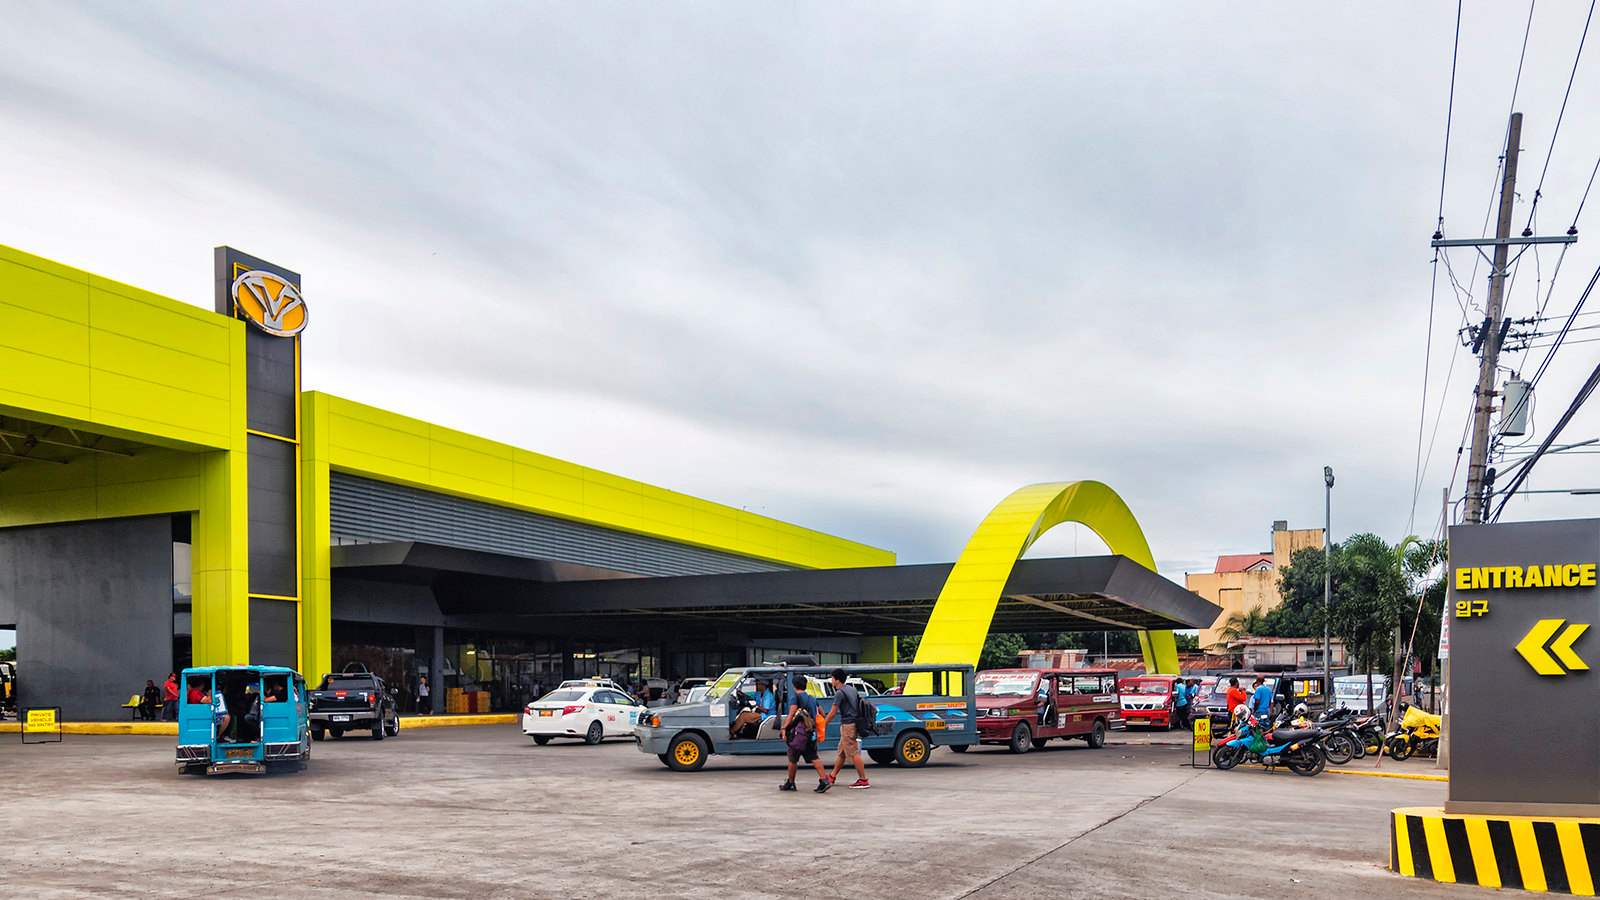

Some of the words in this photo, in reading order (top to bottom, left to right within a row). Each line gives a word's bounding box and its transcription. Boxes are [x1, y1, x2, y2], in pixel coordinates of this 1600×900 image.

[1455, 563, 1596, 590] ENTRANCE
[1455, 600, 1489, 618] 입구
[1198, 722, 1206, 732] NO
[1194, 734, 1210, 744] PARKING
